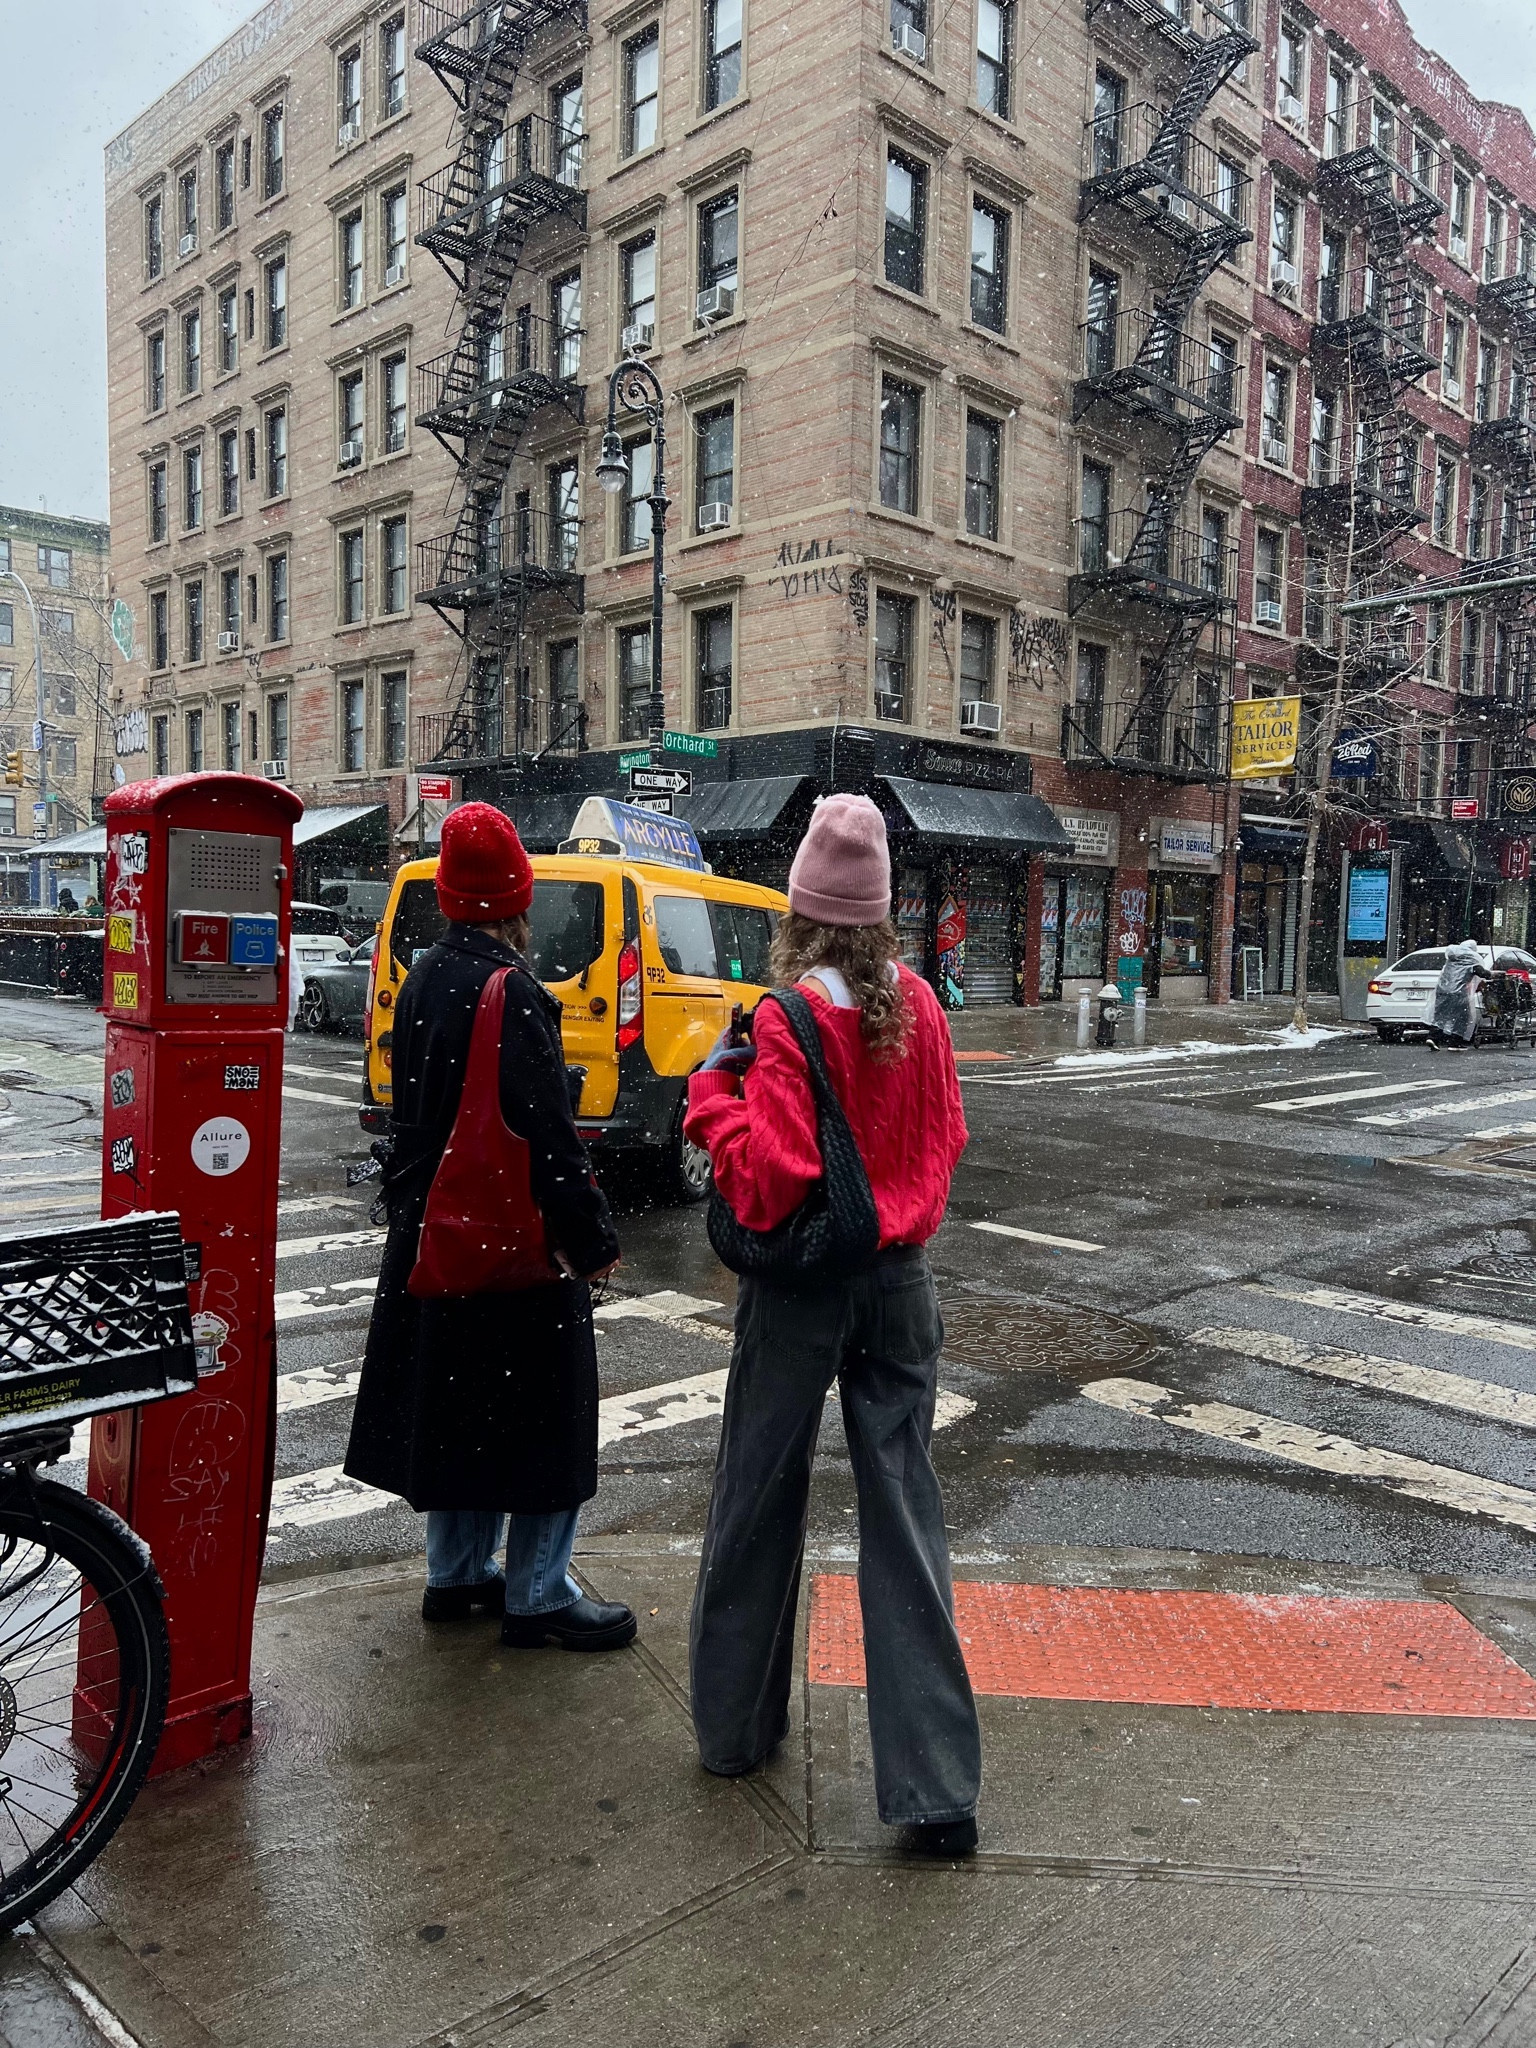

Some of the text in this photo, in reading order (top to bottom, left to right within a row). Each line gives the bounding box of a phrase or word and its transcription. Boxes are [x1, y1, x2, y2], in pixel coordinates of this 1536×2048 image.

[1235, 720, 1293, 742] TAILOR
[665, 733, 714, 753] Orchard St
[1236, 740, 1293, 755] SERVICES
[965, 761, 1014, 781] PIZZRIA
[640, 775, 682, 787] ONE WAY
[1513, 786, 1532, 804] NYC
[652, 800, 666, 810] WAY
[623, 816, 696, 858] ARGYLLE
[1163, 837, 1184, 851] TAILOR
[578, 838, 600, 853] 9P32
[192, 921, 275, 936] Fire Police
[646, 967, 665, 984] 9P32
[200, 1132, 242, 1142] Allure
[13, 1384, 49, 1400] FARMS
[51, 1378, 81, 1392] DAIRY
